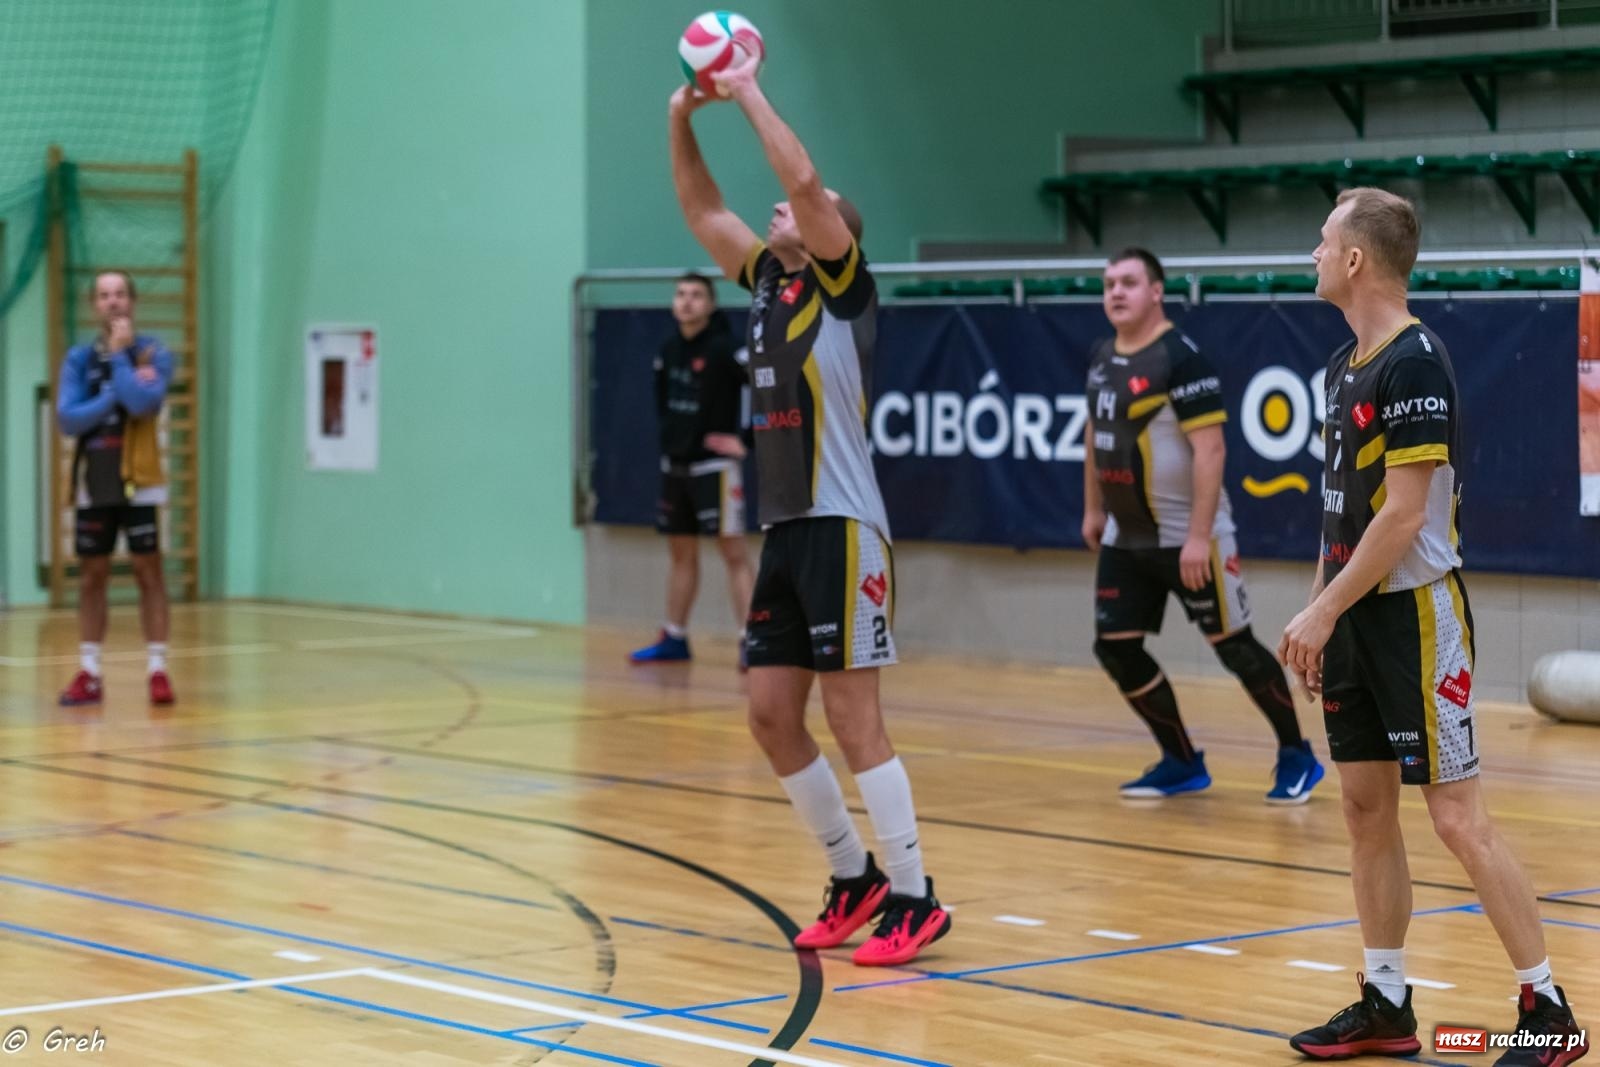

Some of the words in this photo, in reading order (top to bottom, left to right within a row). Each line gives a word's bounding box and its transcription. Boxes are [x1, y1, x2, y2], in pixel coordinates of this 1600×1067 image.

[868, 369, 1088, 461] CIBÓRZ
[1096, 389, 1117, 420] 14
[872, 614, 888, 649] 2
[1443, 679, 1467, 698] Enter
